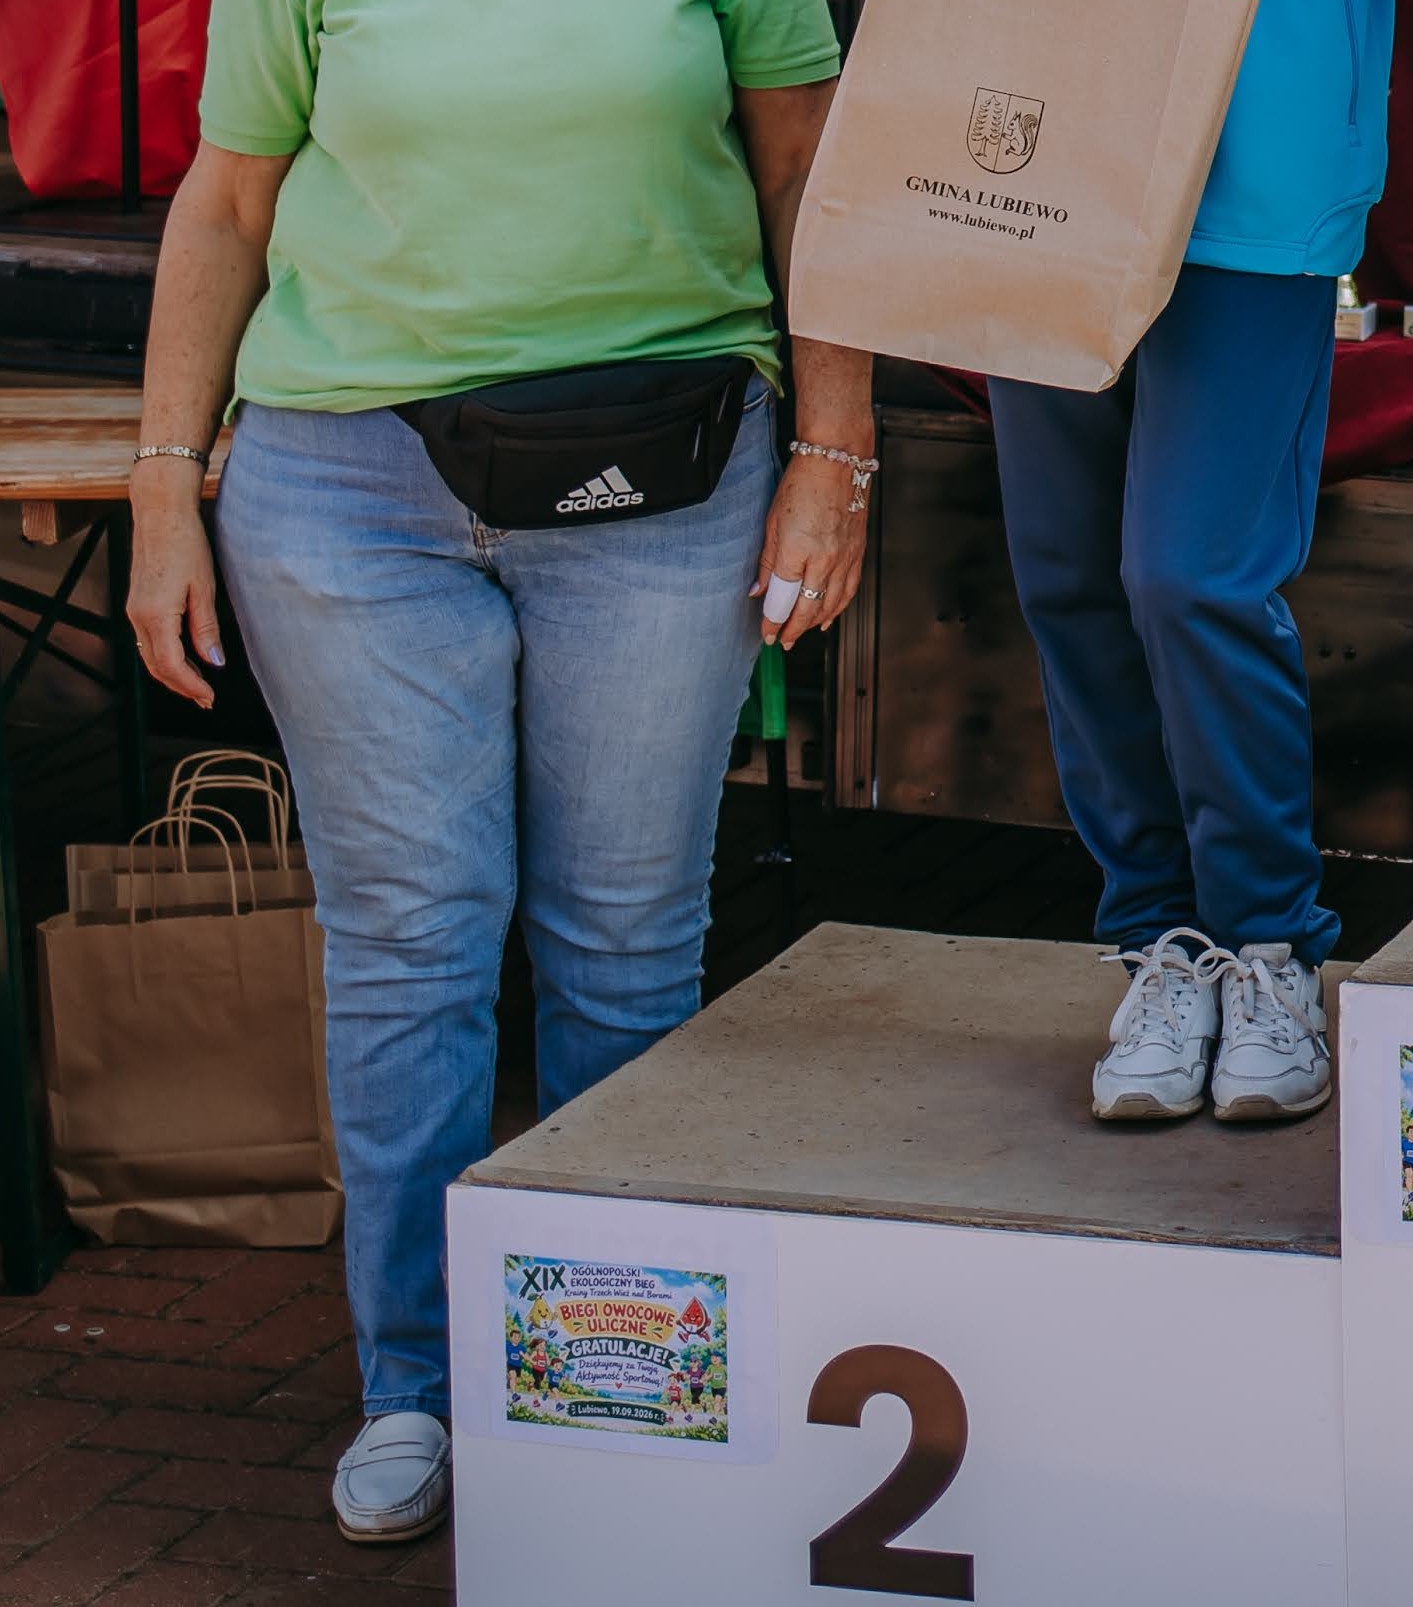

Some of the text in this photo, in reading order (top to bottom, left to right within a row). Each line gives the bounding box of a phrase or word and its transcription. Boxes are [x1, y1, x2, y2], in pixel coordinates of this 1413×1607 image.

[905, 175, 1069, 224] GMINA LUBIEWO
[928, 206, 1036, 241] www.lubiewo.pl
[555, 492, 645, 513] adidas
[571, 1265, 641, 1277] OGÓLNOPOLSKI
[519, 1265, 567, 1299] XIX
[570, 1277, 656, 1289] EKOLOGICZNY BIEG
[564, 1288, 588, 1298] Krainy
[590, 1288, 612, 1297] Trzech
[631, 1289, 645, 1297] nad
[647, 1290, 672, 1299] Borami
[559, 1303, 676, 1328] BIEGI OWOCOWE
[587, 1319, 647, 1335] ULICZNE
[571, 1338, 668, 1364] GRATULACJE!
[578, 1358, 659, 1374] Dziękujemy za Twoją
[575, 1370, 664, 1387] Aktywność Sportową!
[577, 1404, 610, 1416] Lubiewo,
[611, 1405, 653, 1418] 19.09.2026
[806, 1344, 975, 1602] 2
